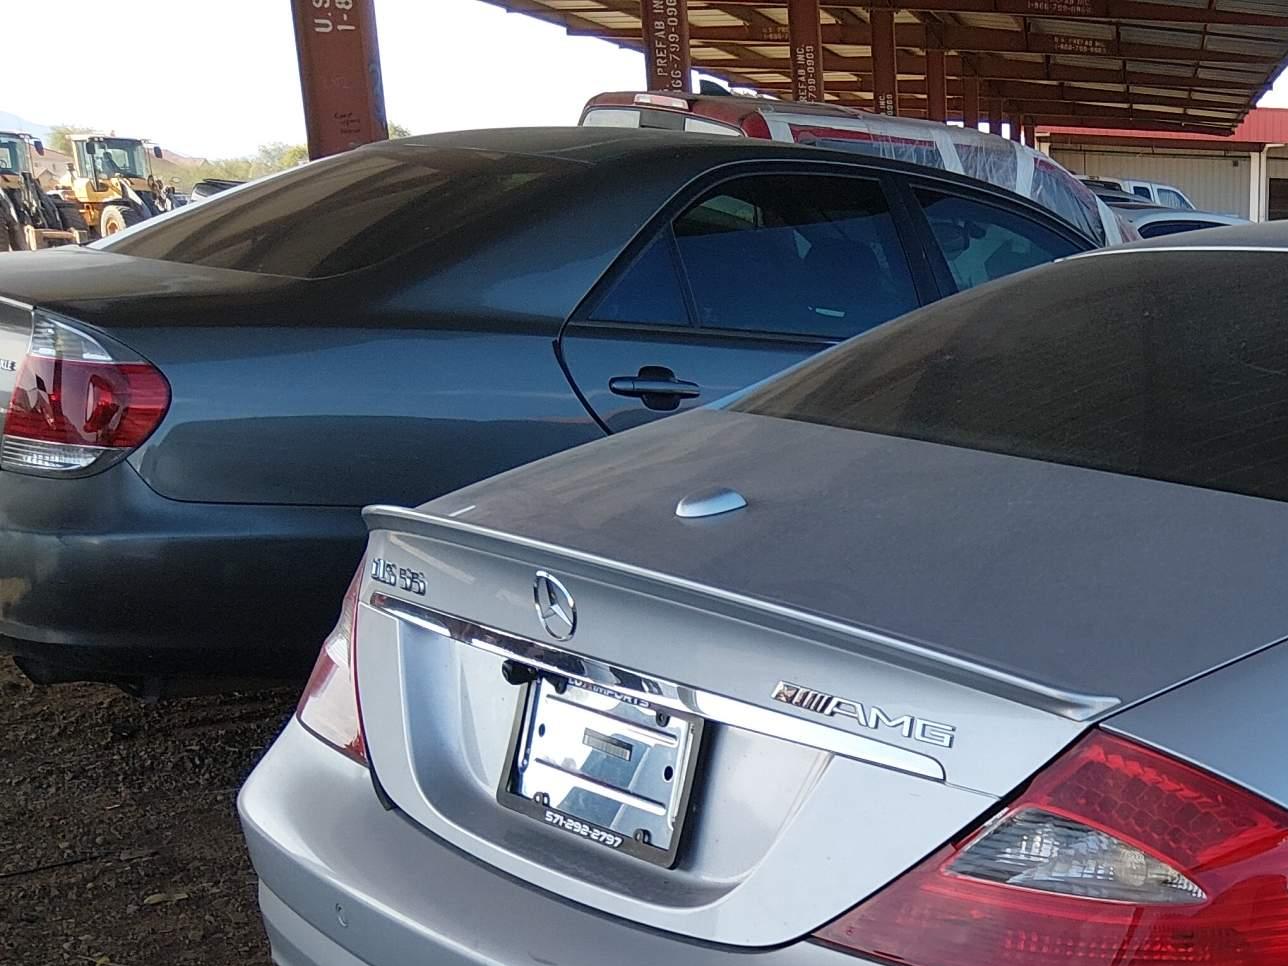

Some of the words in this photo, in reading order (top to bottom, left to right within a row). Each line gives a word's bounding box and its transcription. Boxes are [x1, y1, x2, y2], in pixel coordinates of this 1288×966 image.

[655, 21, 669, 76] PREFAB
[824, 697, 957, 749] AMG
[545, 810, 623, 848] 571-292-2797
